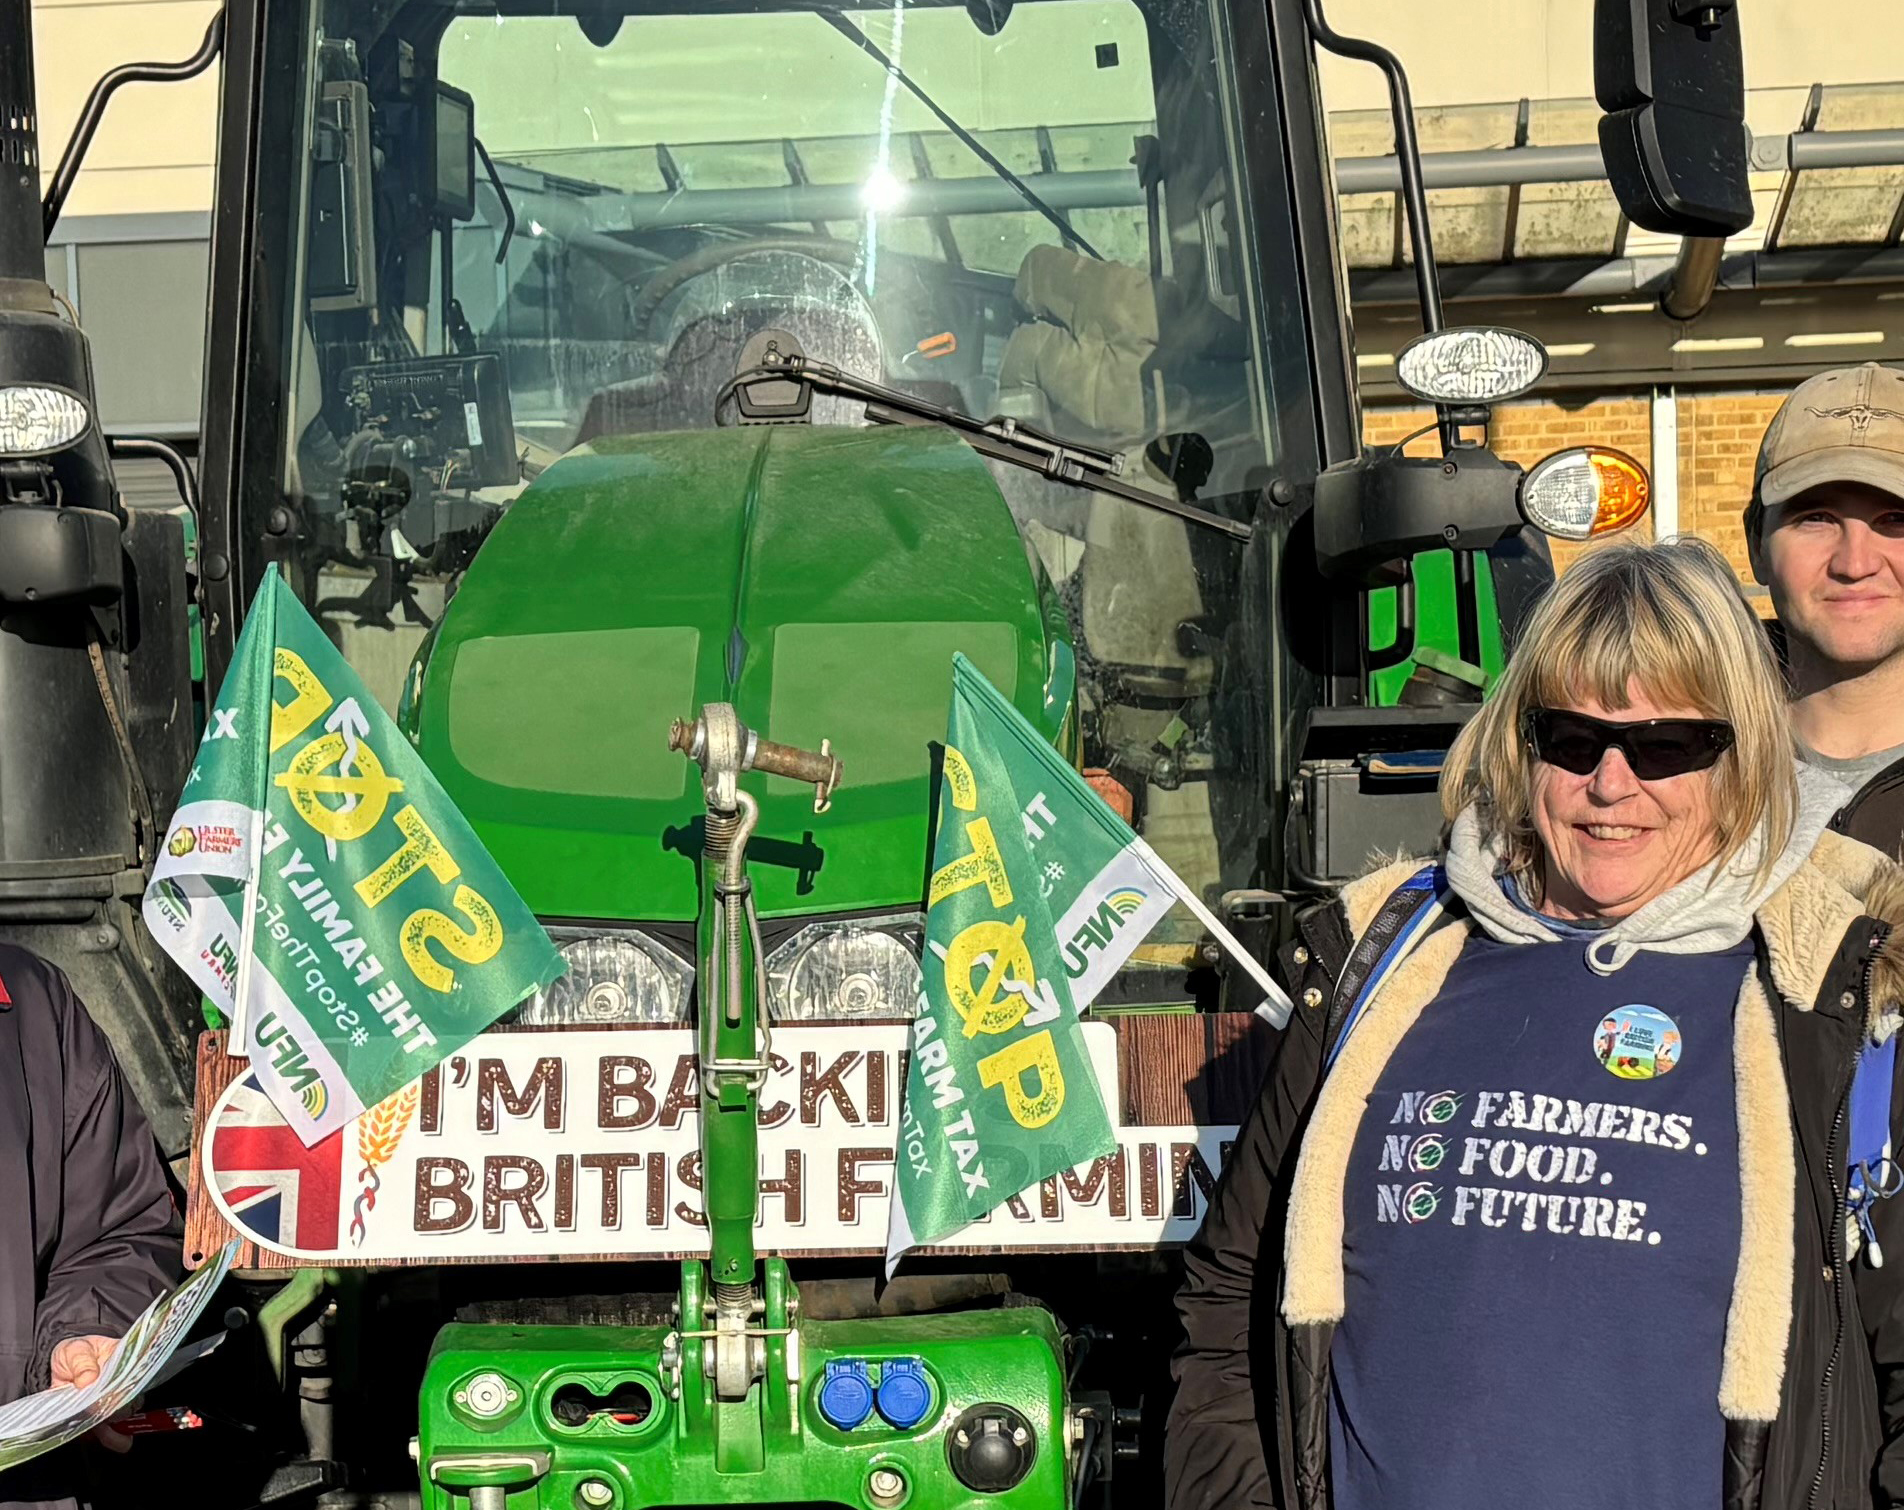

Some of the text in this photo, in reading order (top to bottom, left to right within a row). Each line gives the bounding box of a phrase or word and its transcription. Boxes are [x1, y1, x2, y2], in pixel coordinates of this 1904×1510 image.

[419, 1049, 910, 1136] I'M BACKI
[1389, 1089, 1707, 1156] NO FARMERS.
[943, 1109, 991, 1200] TAX
[1378, 1133, 1613, 1185] NO FOOD.
[1377, 1181, 1662, 1246] NO FUTURE.
